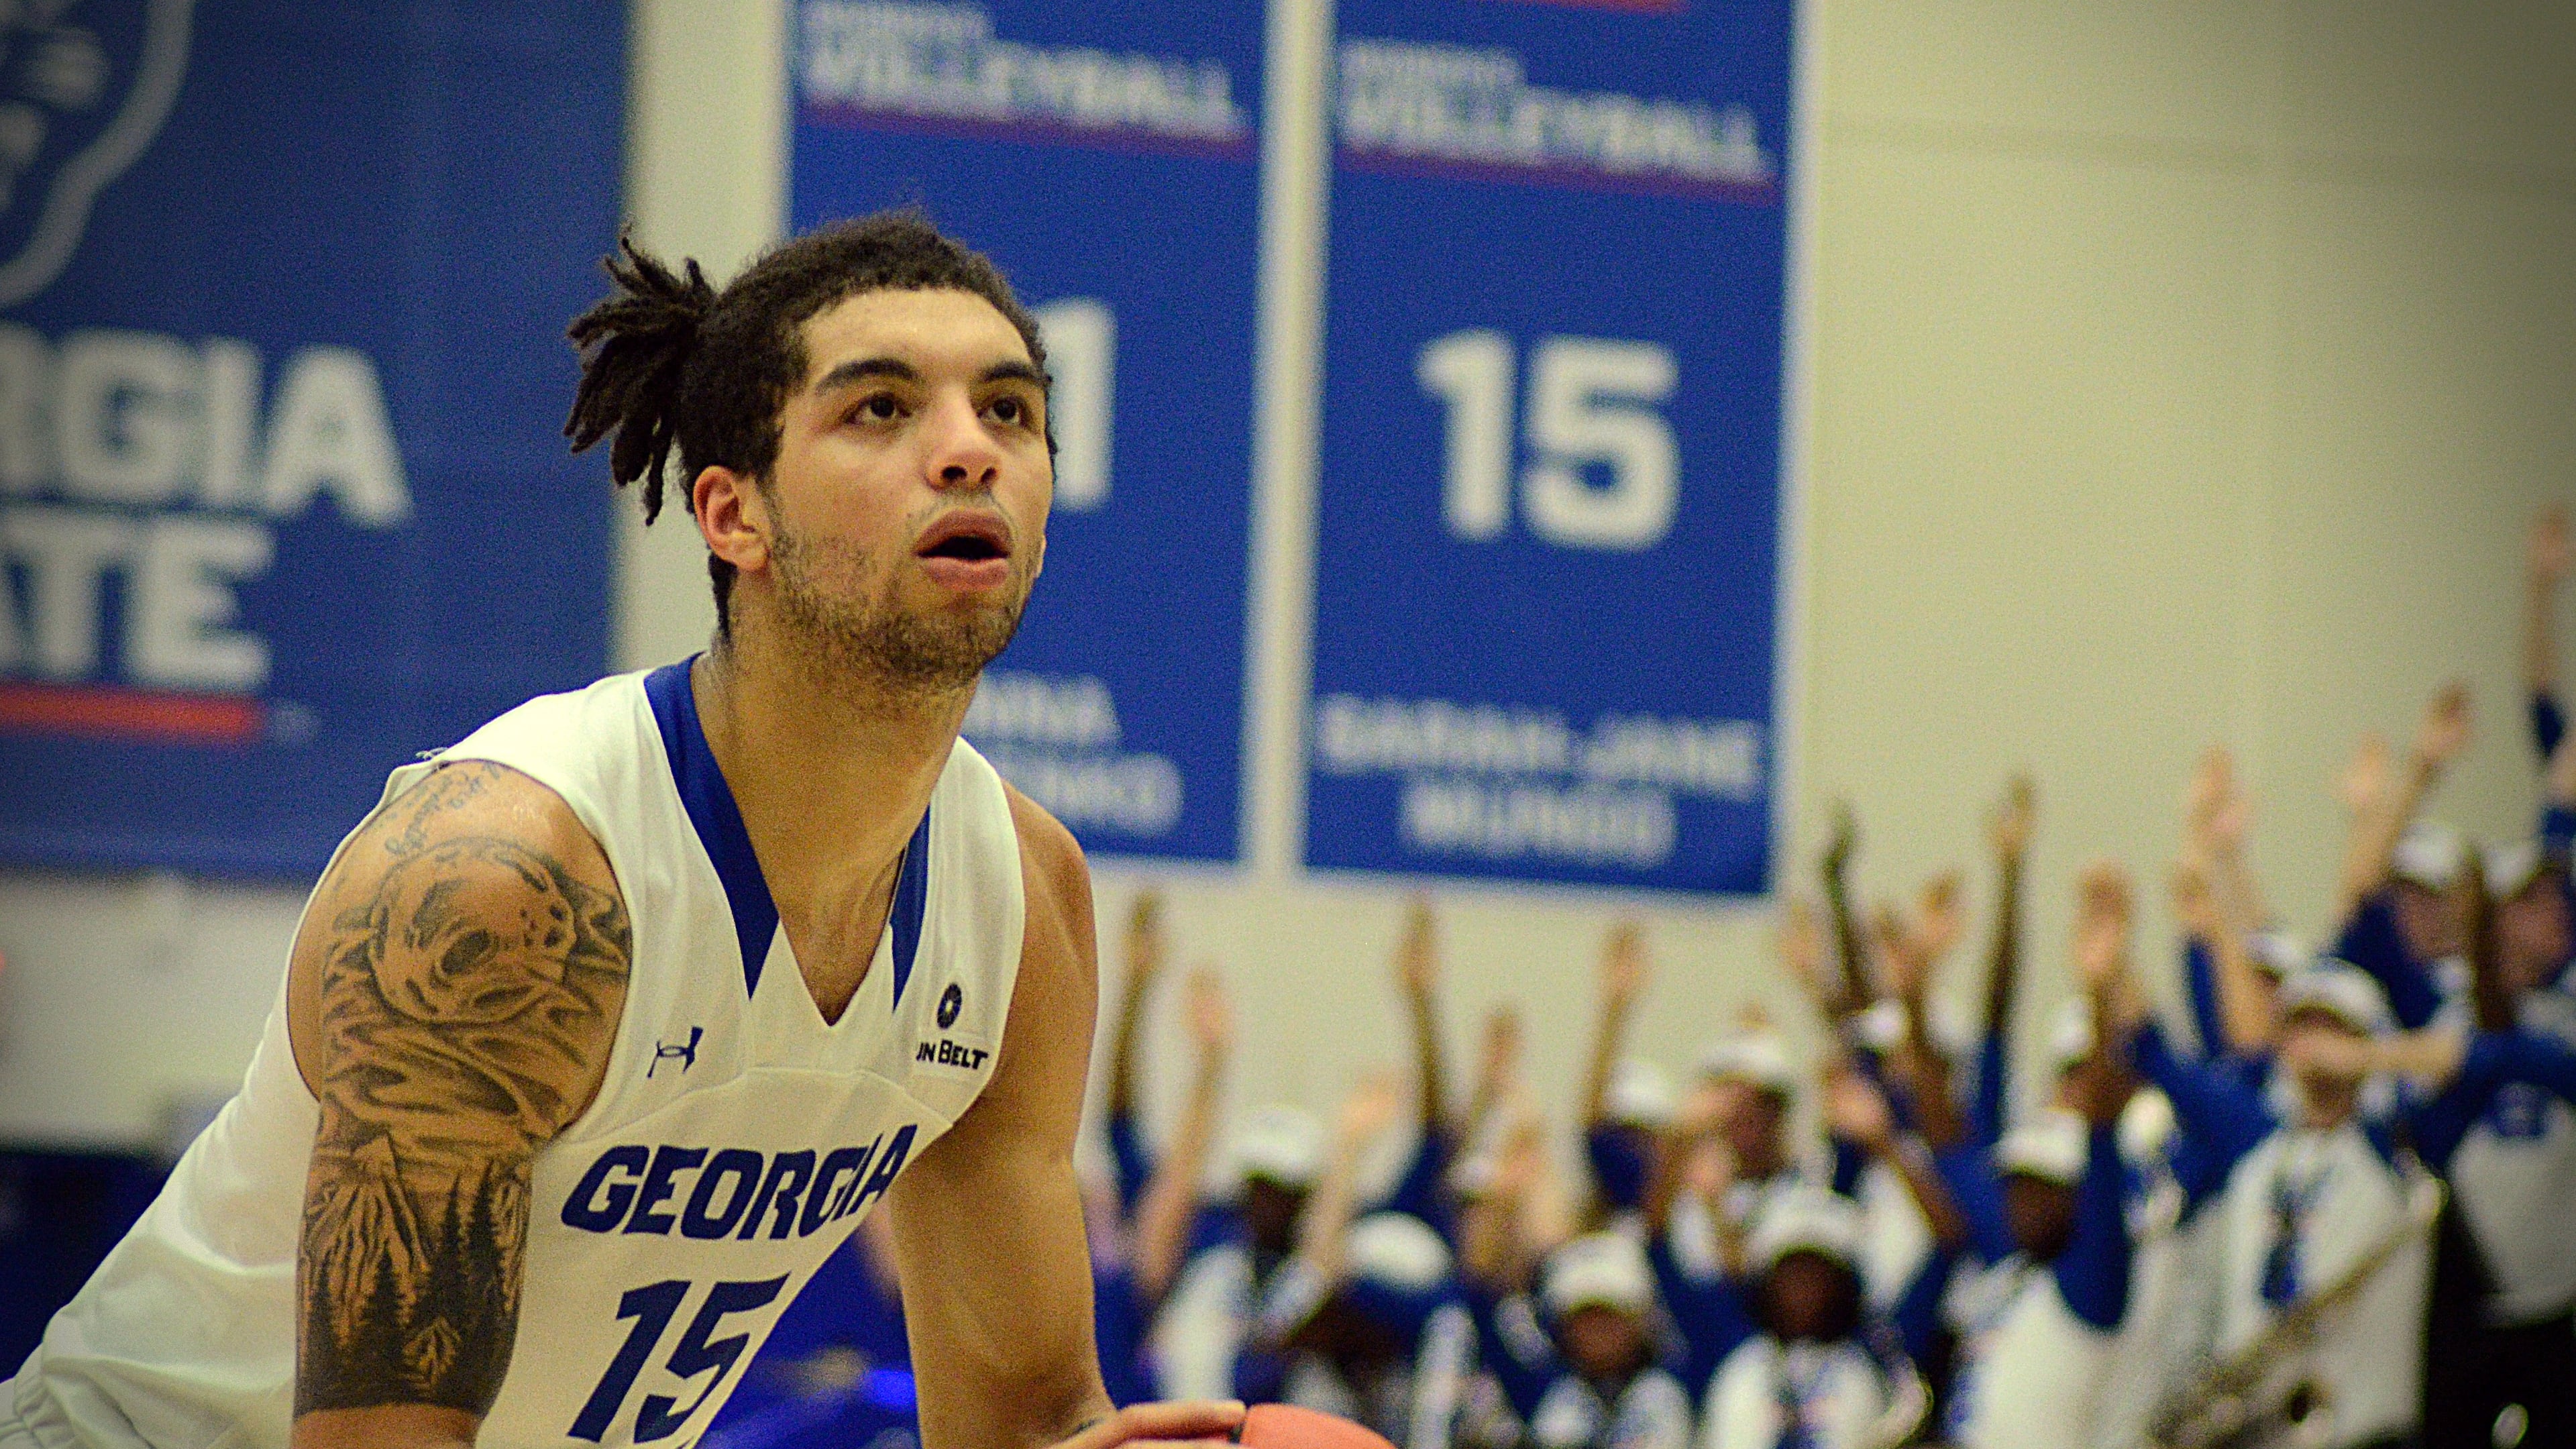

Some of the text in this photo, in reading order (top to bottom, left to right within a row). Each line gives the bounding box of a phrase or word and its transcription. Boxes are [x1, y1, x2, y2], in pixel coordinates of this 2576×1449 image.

[1417, 330, 1681, 551] 15
[938, 1039, 988, 1069] BELT
[561, 1124, 918, 1240] GEORGIA
[567, 1271, 792, 1444] 15
